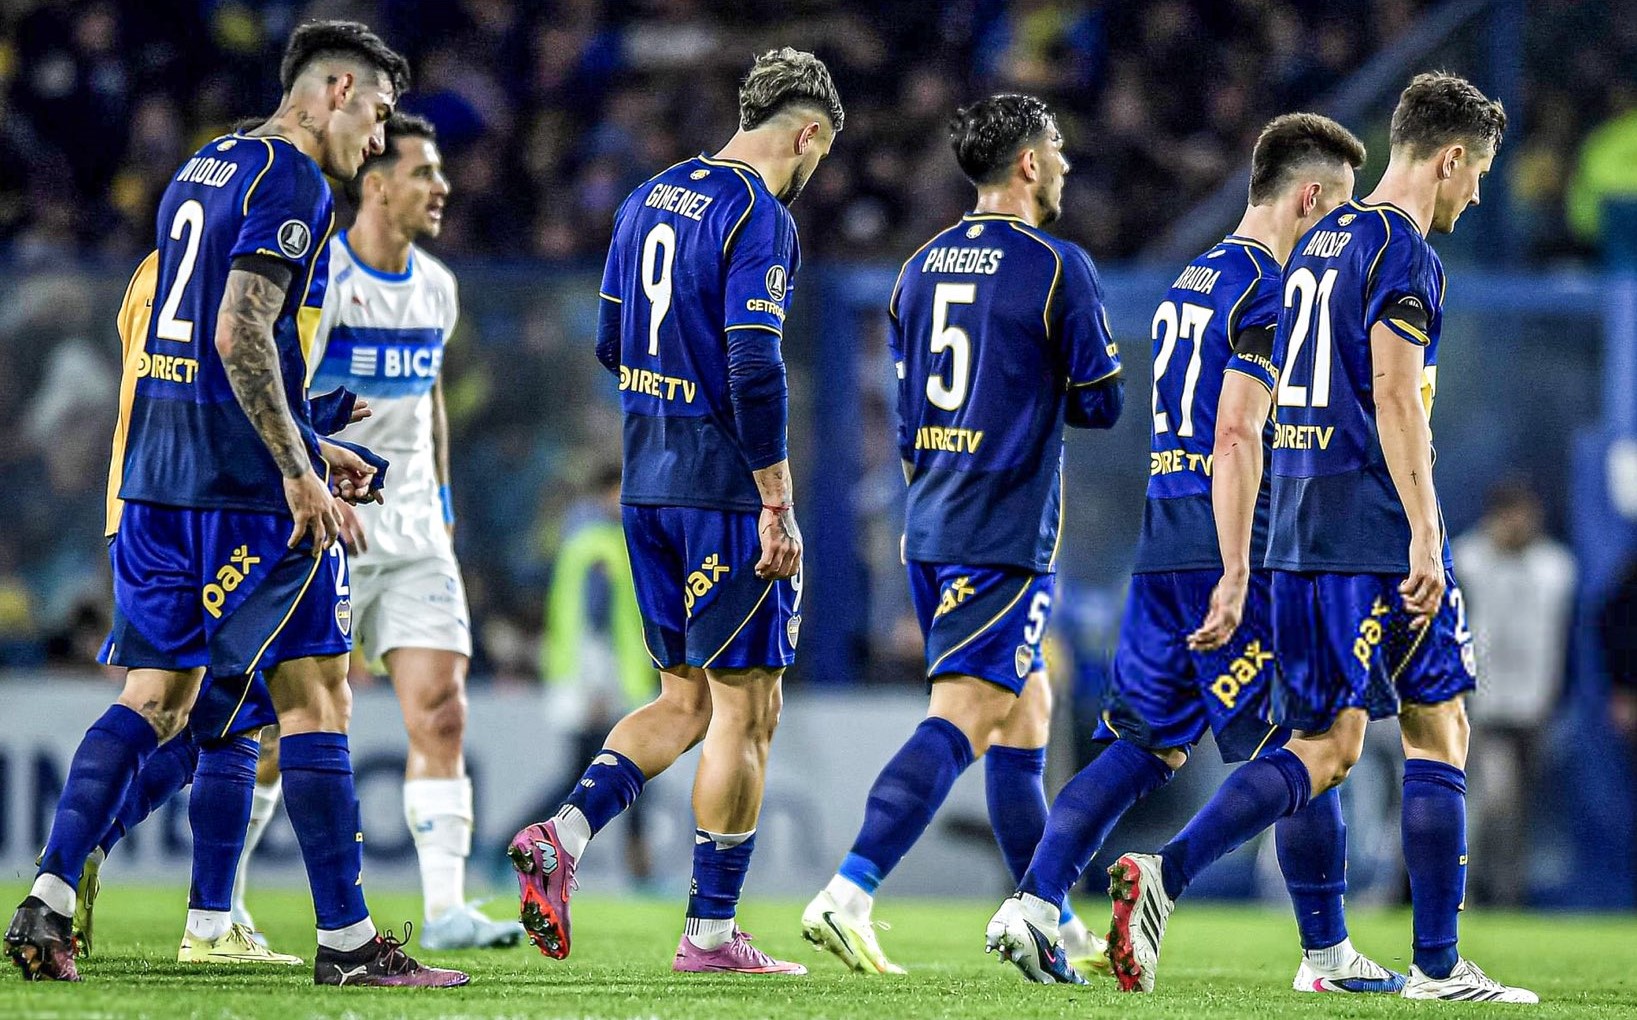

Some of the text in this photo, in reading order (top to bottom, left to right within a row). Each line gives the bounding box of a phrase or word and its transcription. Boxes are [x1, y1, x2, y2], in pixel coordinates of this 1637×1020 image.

[645, 183, 713, 221] GIMENEZ
[157, 199, 205, 343] 2
[641, 222, 676, 356] 9
[921, 247, 1004, 275] PAREDES
[926, 282, 977, 411] 5
[1151, 300, 1214, 437] 27
[1277, 266, 1338, 408] 21
[1272, 422, 1335, 450] DIRETV
[202, 544, 260, 619] pax
[329, 540, 350, 596] 2
[935, 576, 975, 618] ax
[1023, 590, 1051, 645] 5
[1210, 640, 1274, 709] pax
